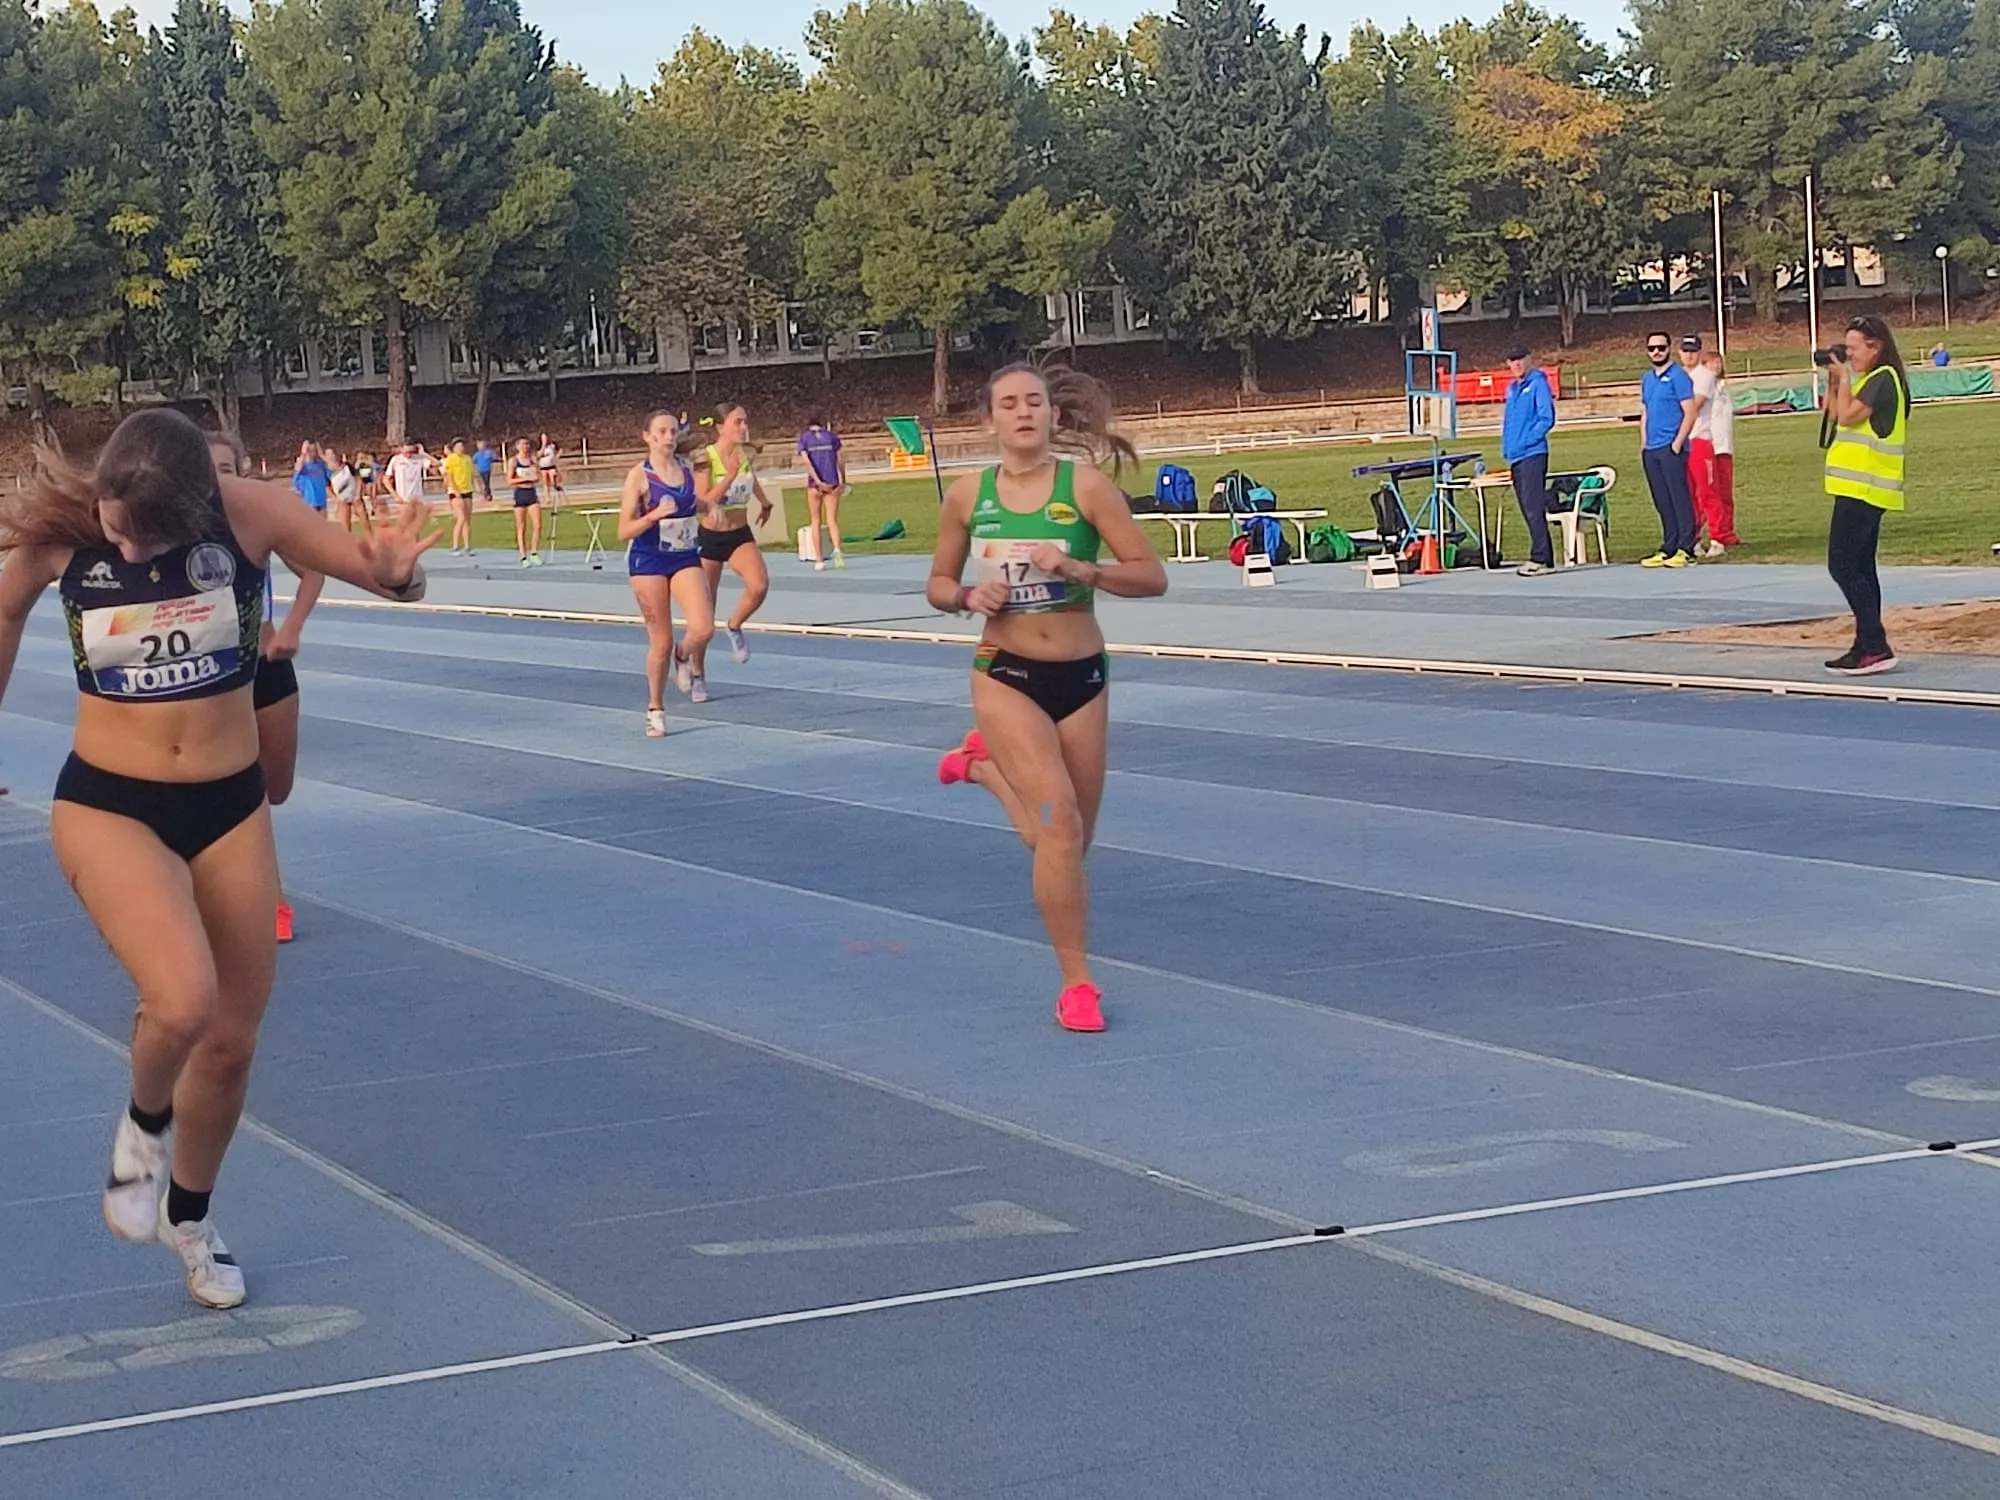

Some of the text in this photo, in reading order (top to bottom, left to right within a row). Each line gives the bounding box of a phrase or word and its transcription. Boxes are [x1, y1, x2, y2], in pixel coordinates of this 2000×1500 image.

[1000, 562, 1031, 583] 17
[1010, 585, 1051, 603] ma
[141, 629, 191, 664] 20
